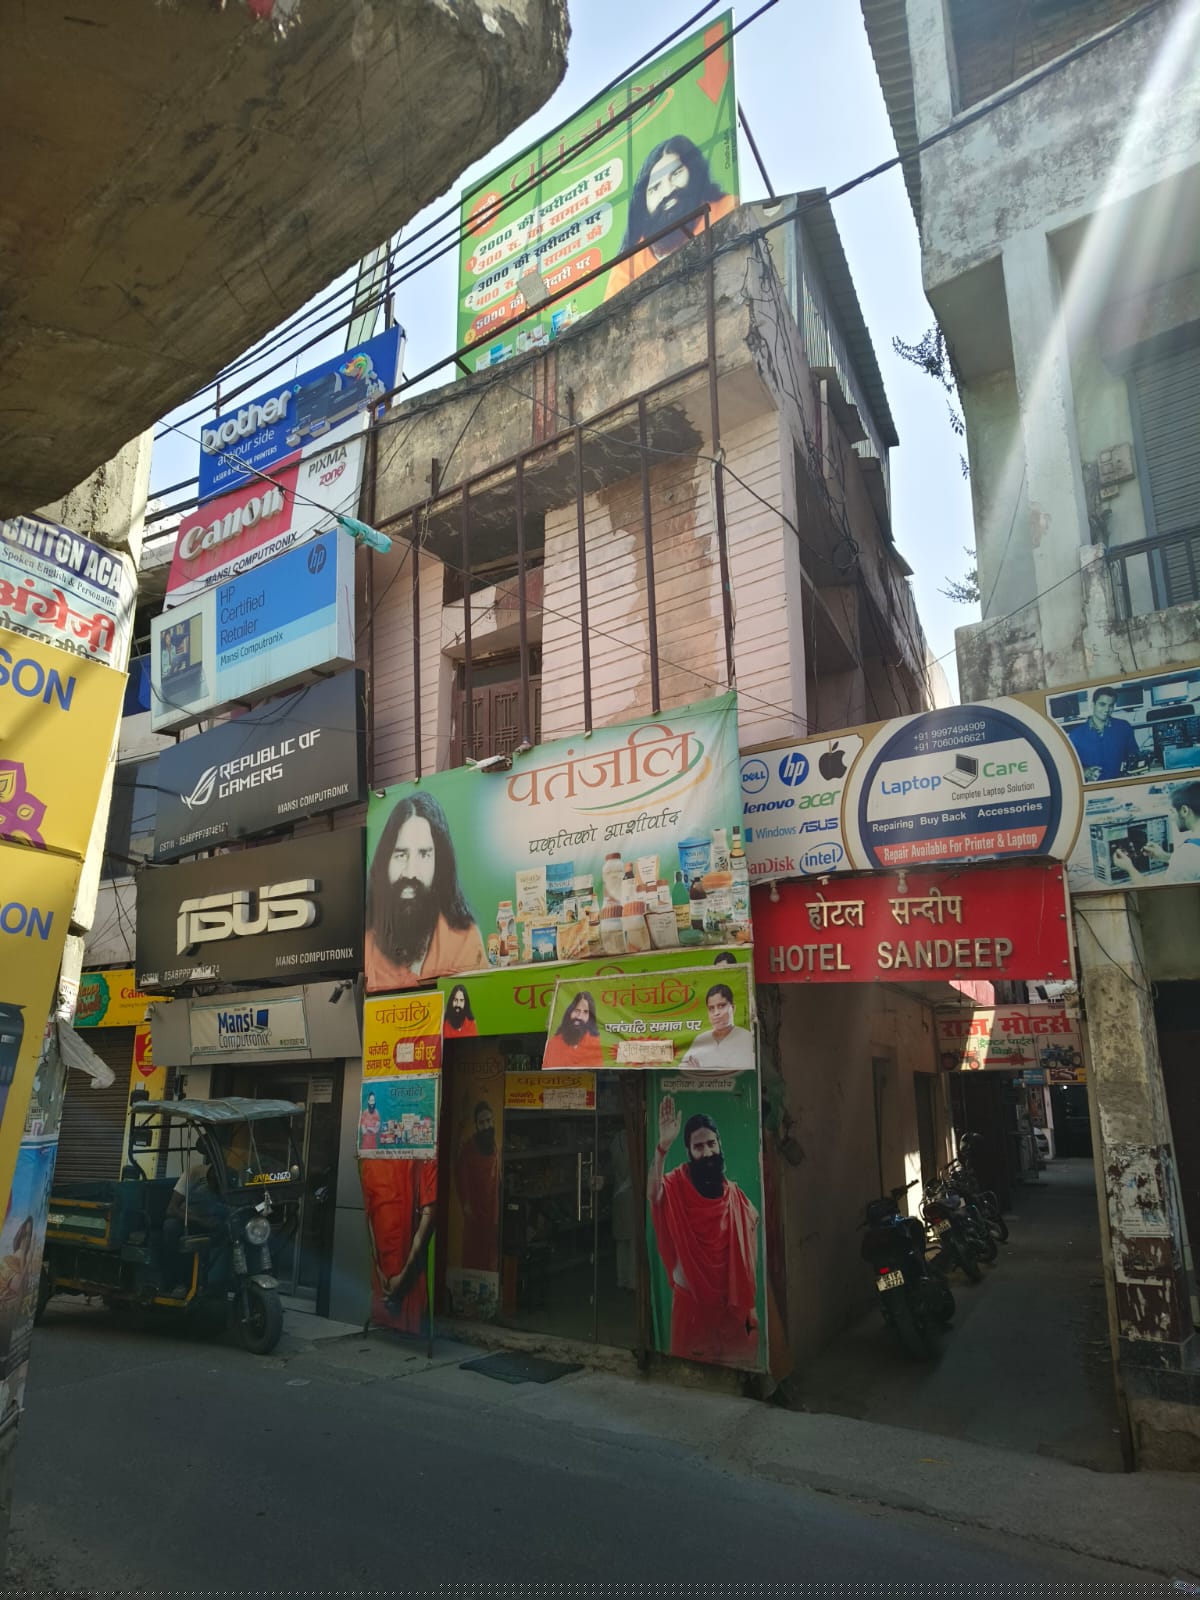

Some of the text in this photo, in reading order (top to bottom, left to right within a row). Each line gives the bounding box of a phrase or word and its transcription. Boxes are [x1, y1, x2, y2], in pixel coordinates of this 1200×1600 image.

[479, 229, 512, 256] 2000
[517, 211, 535, 231] की
[594, 166, 611, 184] पर
[478, 266, 509, 292] 3000
[512, 252, 531, 270] की
[534, 221, 581, 257] खरीदारी
[585, 210, 602, 225] पर
[478, 252, 502, 271] 300
[476, 305, 505, 329] 5000
[576, 255, 592, 270] पर
[201, 390, 292, 454] brother
[253, 430, 275, 448] side
[253, 446, 277, 462] PRINTERS
[308, 447, 348, 478] PIXMA
[319, 461, 346, 486] zone
[179, 486, 286, 560] Canon
[2, 516, 86, 571] BRITON
[204, 532, 298, 587] MANSI COMPUTRONIX
[308, 544, 327, 575] hp
[2, 546, 117, 611] Spoken English & Personality
[220, 585, 235, 606] HP
[220, 591, 265, 625] Certified
[220, 618, 258, 648] Retailer
[220, 631, 284, 667] Mansi Computronix
[913, 720, 986, 741] +91 9997494909
[913, 731, 986, 752] +91 7060046621
[219, 728, 321, 779] REPUBLIC OF
[505, 722, 697, 807] पतंजलि
[218, 763, 283, 799] GAMERS
[779, 752, 809, 787] hp
[881, 758, 1029, 796] Laptop Care
[277, 783, 349, 815] MANSI COMPUTRONIX
[744, 798, 795, 815] lenovo
[798, 790, 841, 810] acer
[952, 781, 1036, 802] Complete Laptop Solution
[604, 807, 684, 841] आशीर्वाद
[799, 817, 839, 834] ASUS
[872, 800, 1043, 833] Repairing Buy Back Accessories
[756, 824, 797, 840] Windows
[884, 832, 1038, 862] Repair Available For Printer & Laptop
[748, 855, 796, 875] anDisk
[176, 878, 318, 956] ASUS
[806, 886, 963, 930] होटल सन्दीप
[275, 948, 354, 968] MANSI COMPUTRONIX
[769, 937, 1014, 973] HOTEL SANDEEP
[600, 978, 692, 1008] पतंजलि
[218, 1008, 254, 1034] Mansi
[375, 1000, 428, 1025] पतंजलि
[604, 1019, 703, 1034] पतंजलि समान पर
[939, 1010, 1073, 1036] राज मोटर्स
[218, 1032, 271, 1049] Computronix
[414, 1042, 425, 1062] की
[425, 1044, 437, 1068] छूट
